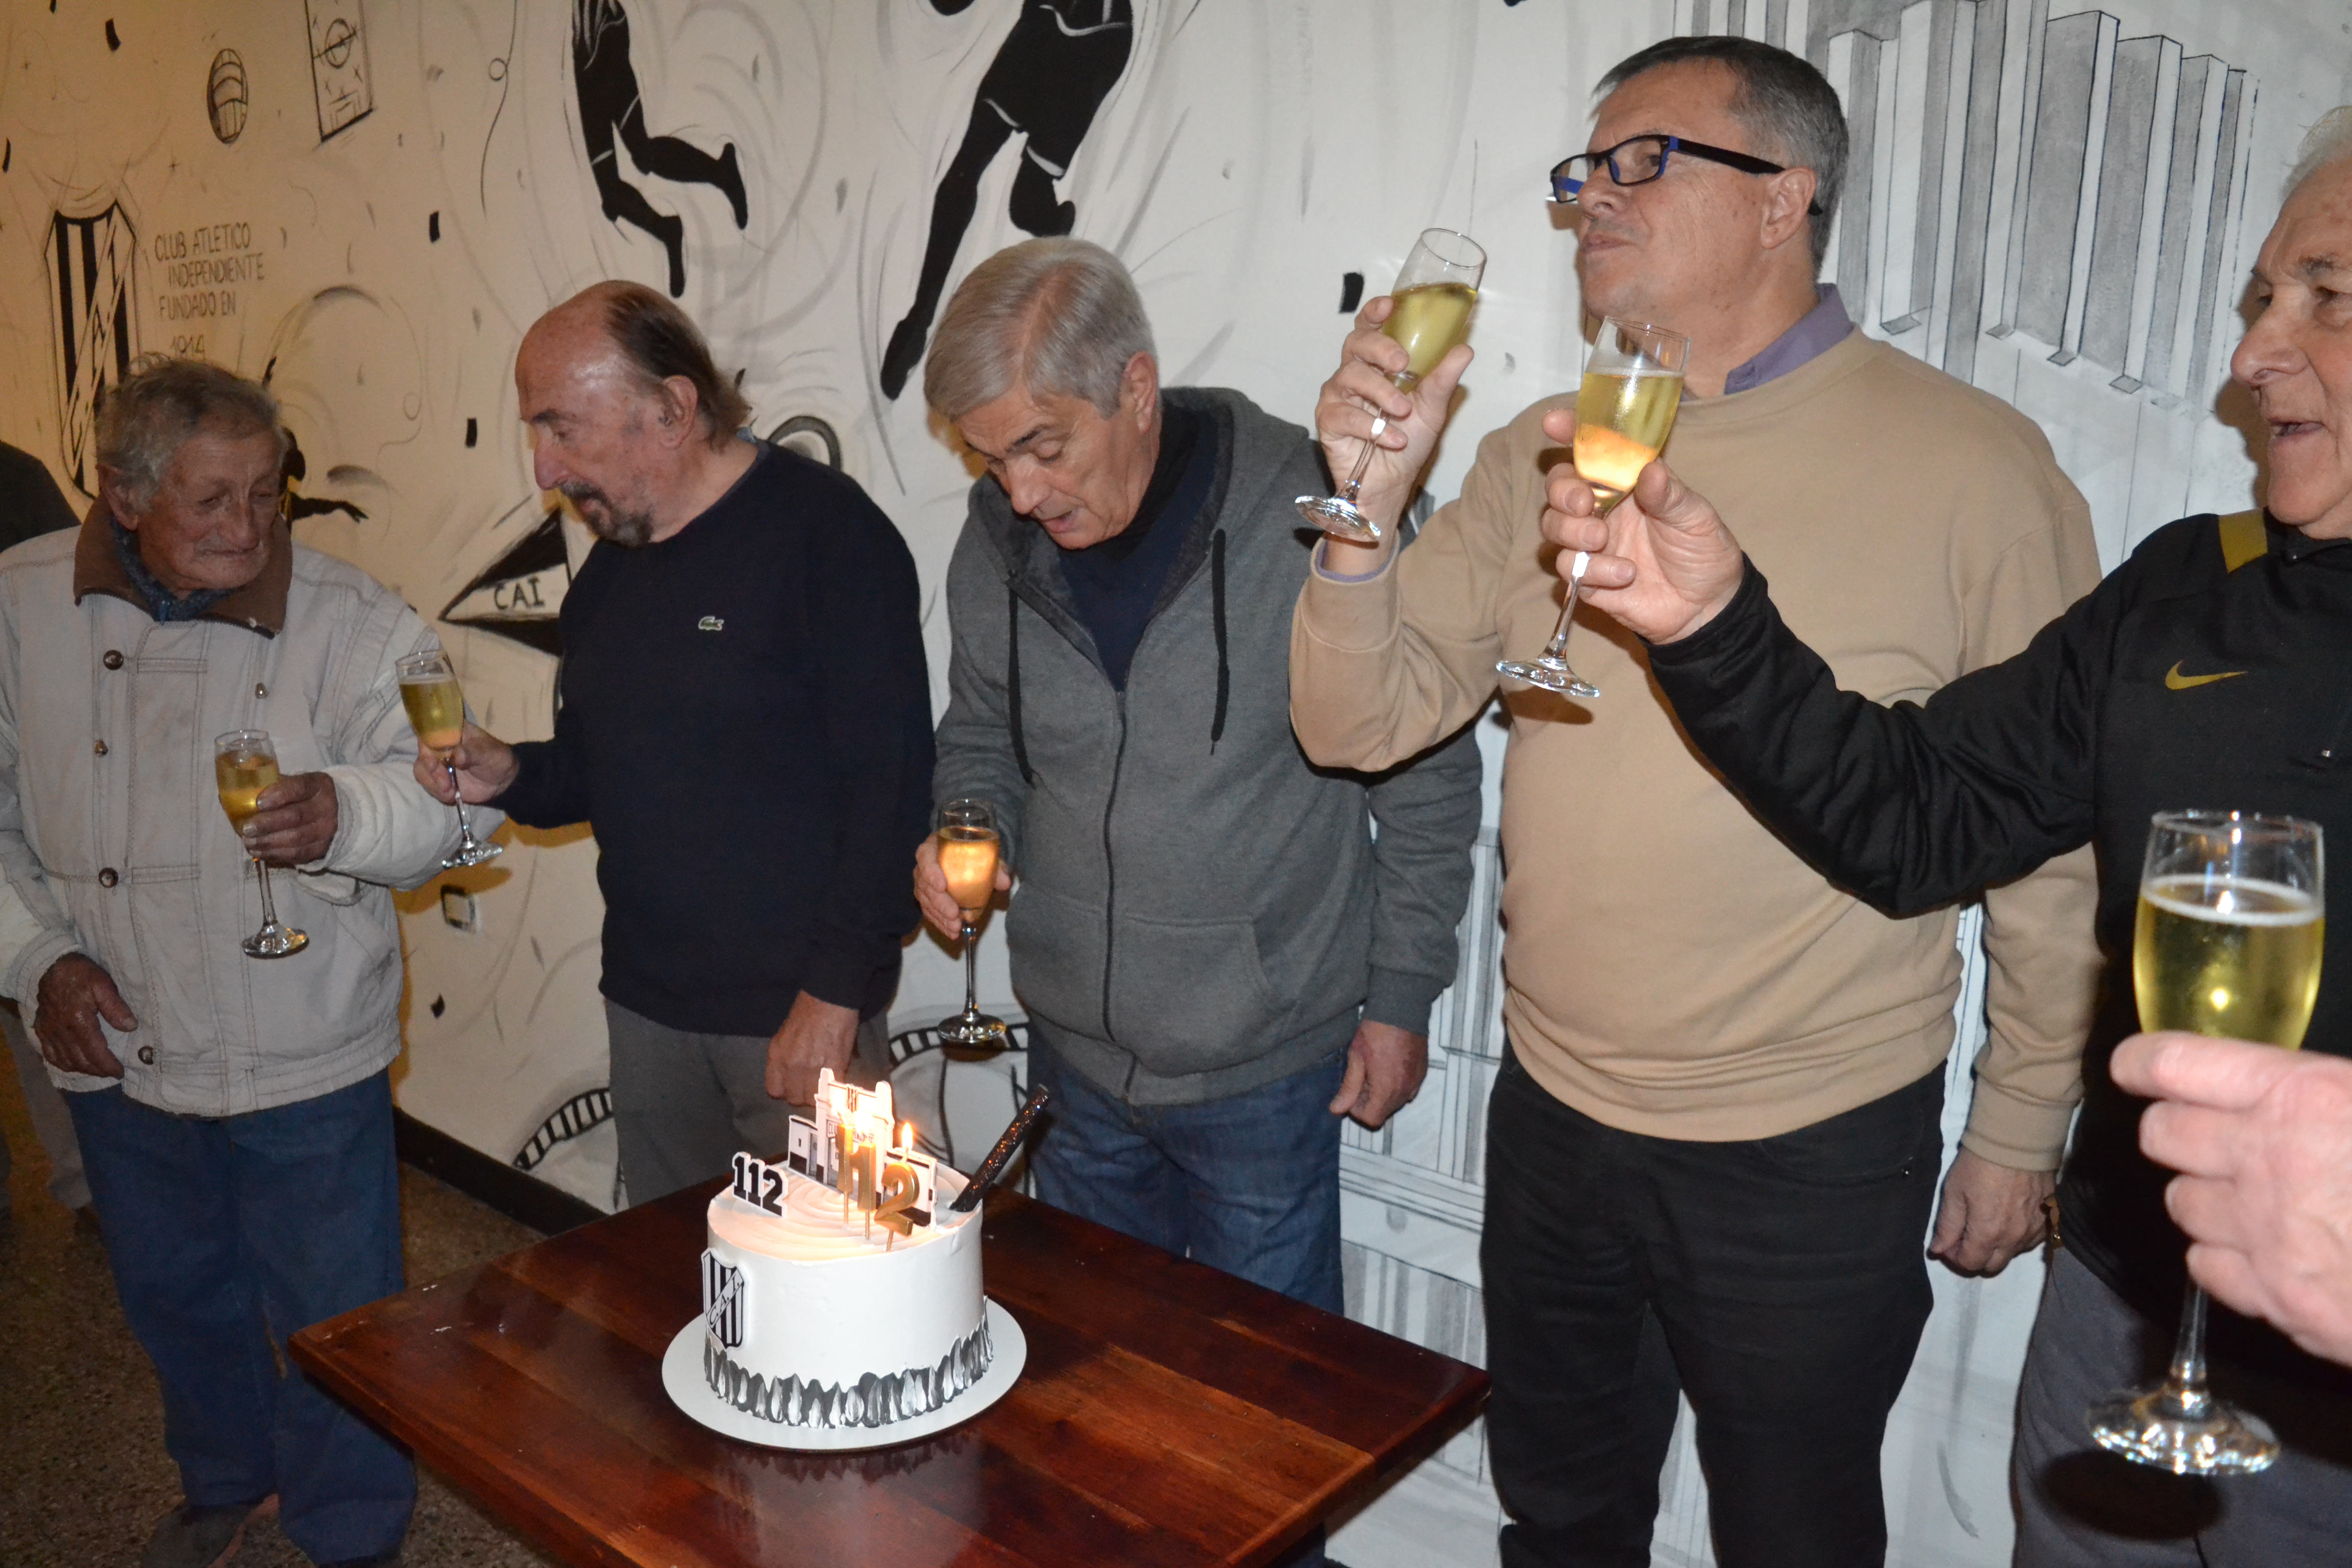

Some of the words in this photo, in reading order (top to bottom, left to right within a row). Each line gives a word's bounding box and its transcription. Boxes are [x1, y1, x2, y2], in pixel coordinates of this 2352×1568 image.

[154, 231, 187, 262] CLUB
[192, 222, 251, 255] ATLETICO
[168, 252, 265, 288] INDEPENDIENTE
[158, 291, 216, 321] FUNDADO
[220, 290, 236, 316] EN
[494, 576, 545, 610] CAI
[734, 1155, 782, 1217] 112
[836, 1124, 920, 1237] 112
